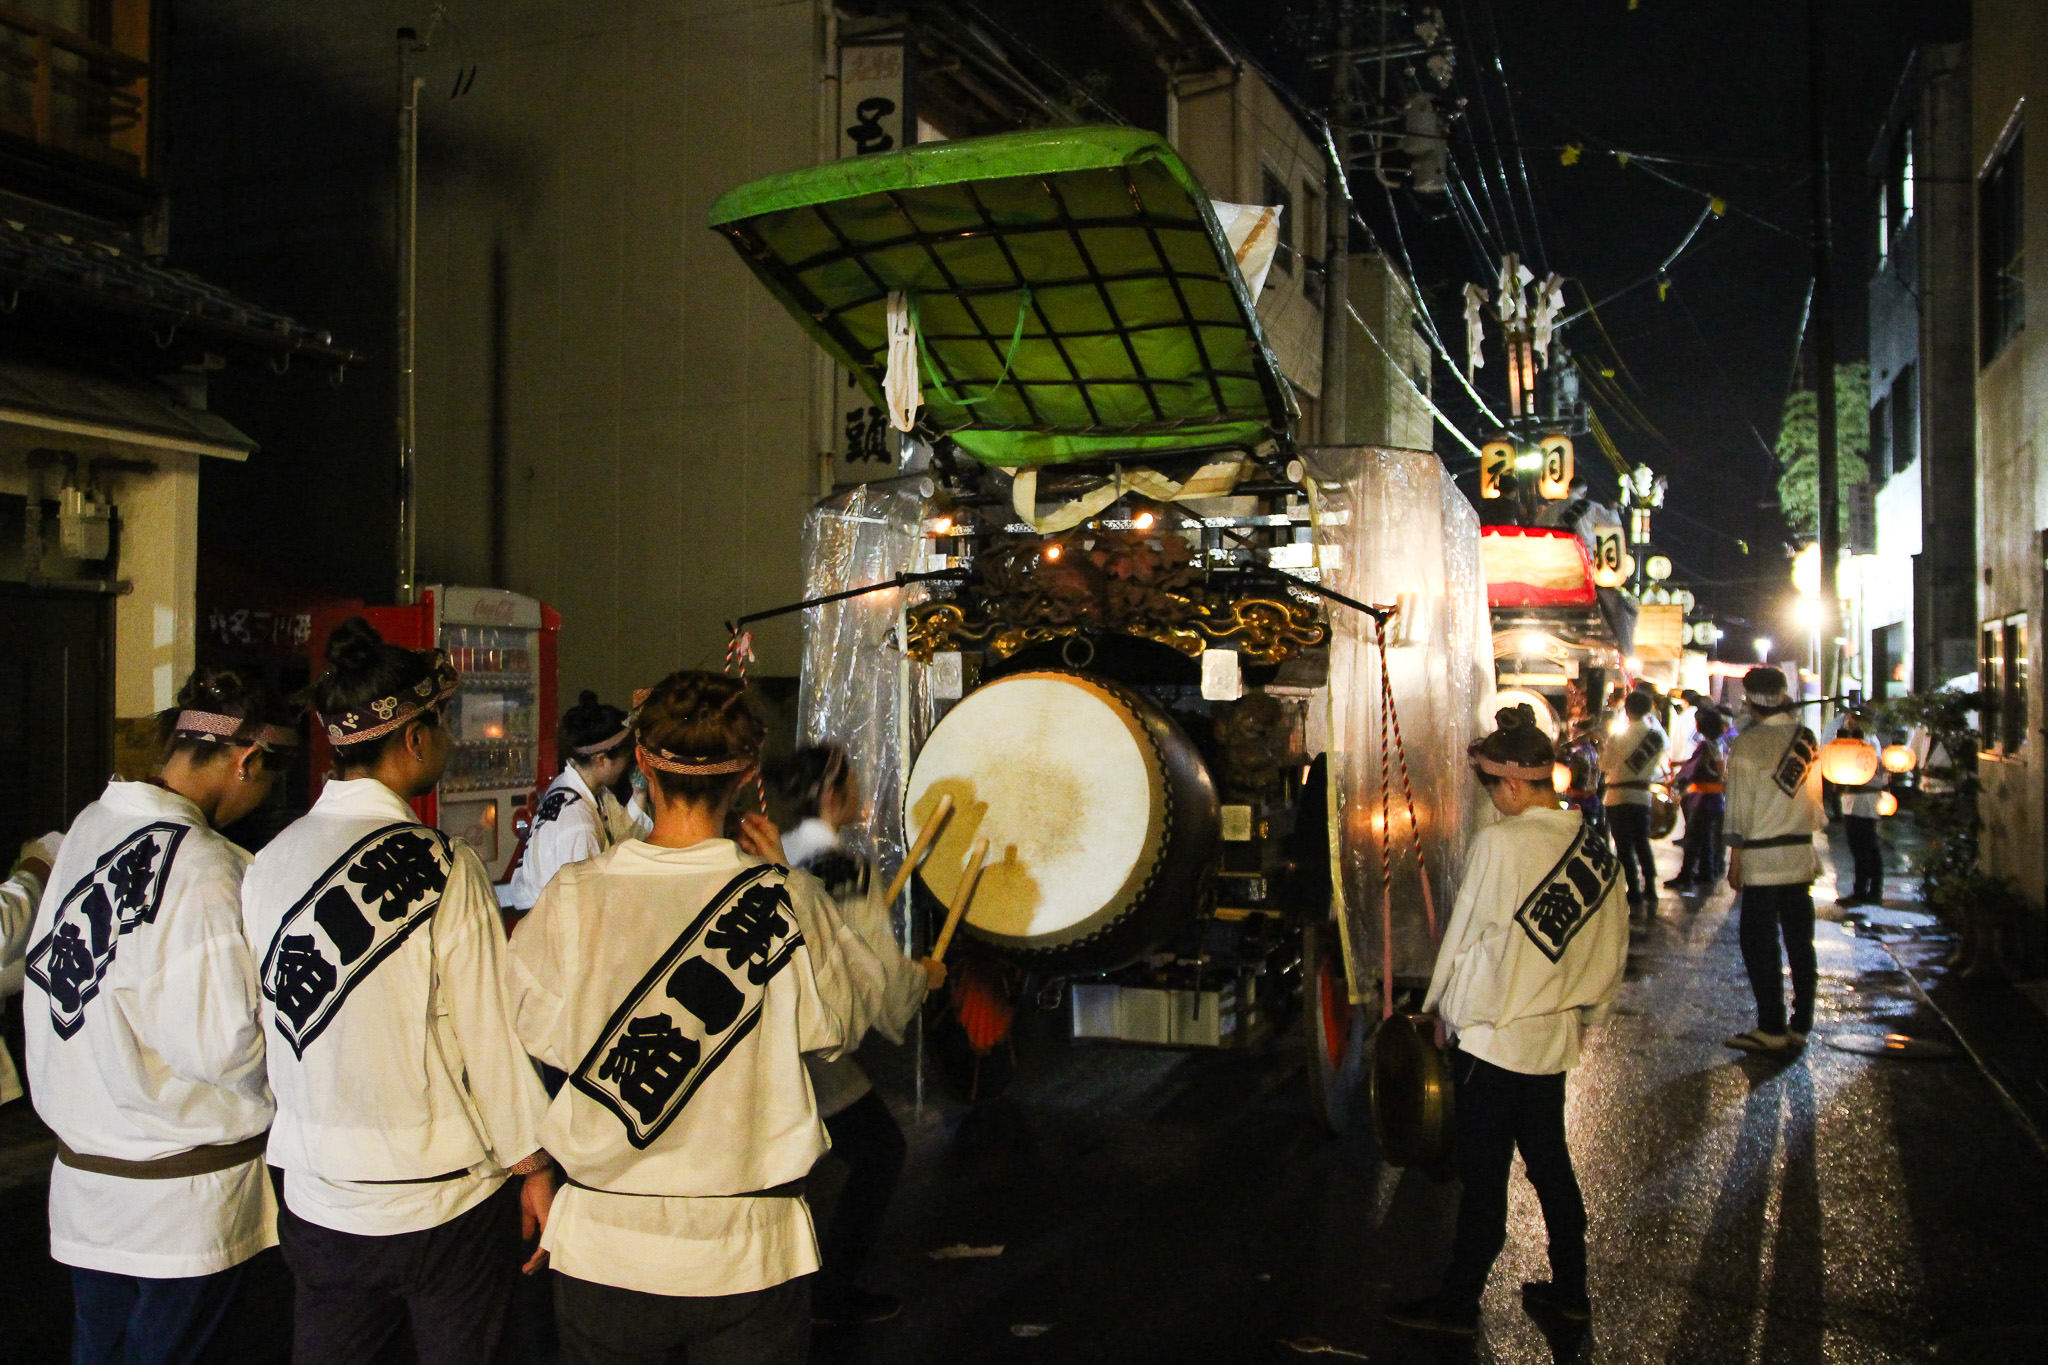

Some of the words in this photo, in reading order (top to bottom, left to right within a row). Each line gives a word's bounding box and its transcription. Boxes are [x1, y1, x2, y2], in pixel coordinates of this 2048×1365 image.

[275, 831, 447, 1033] 第一組
[598, 883, 790, 1125] 第一組
